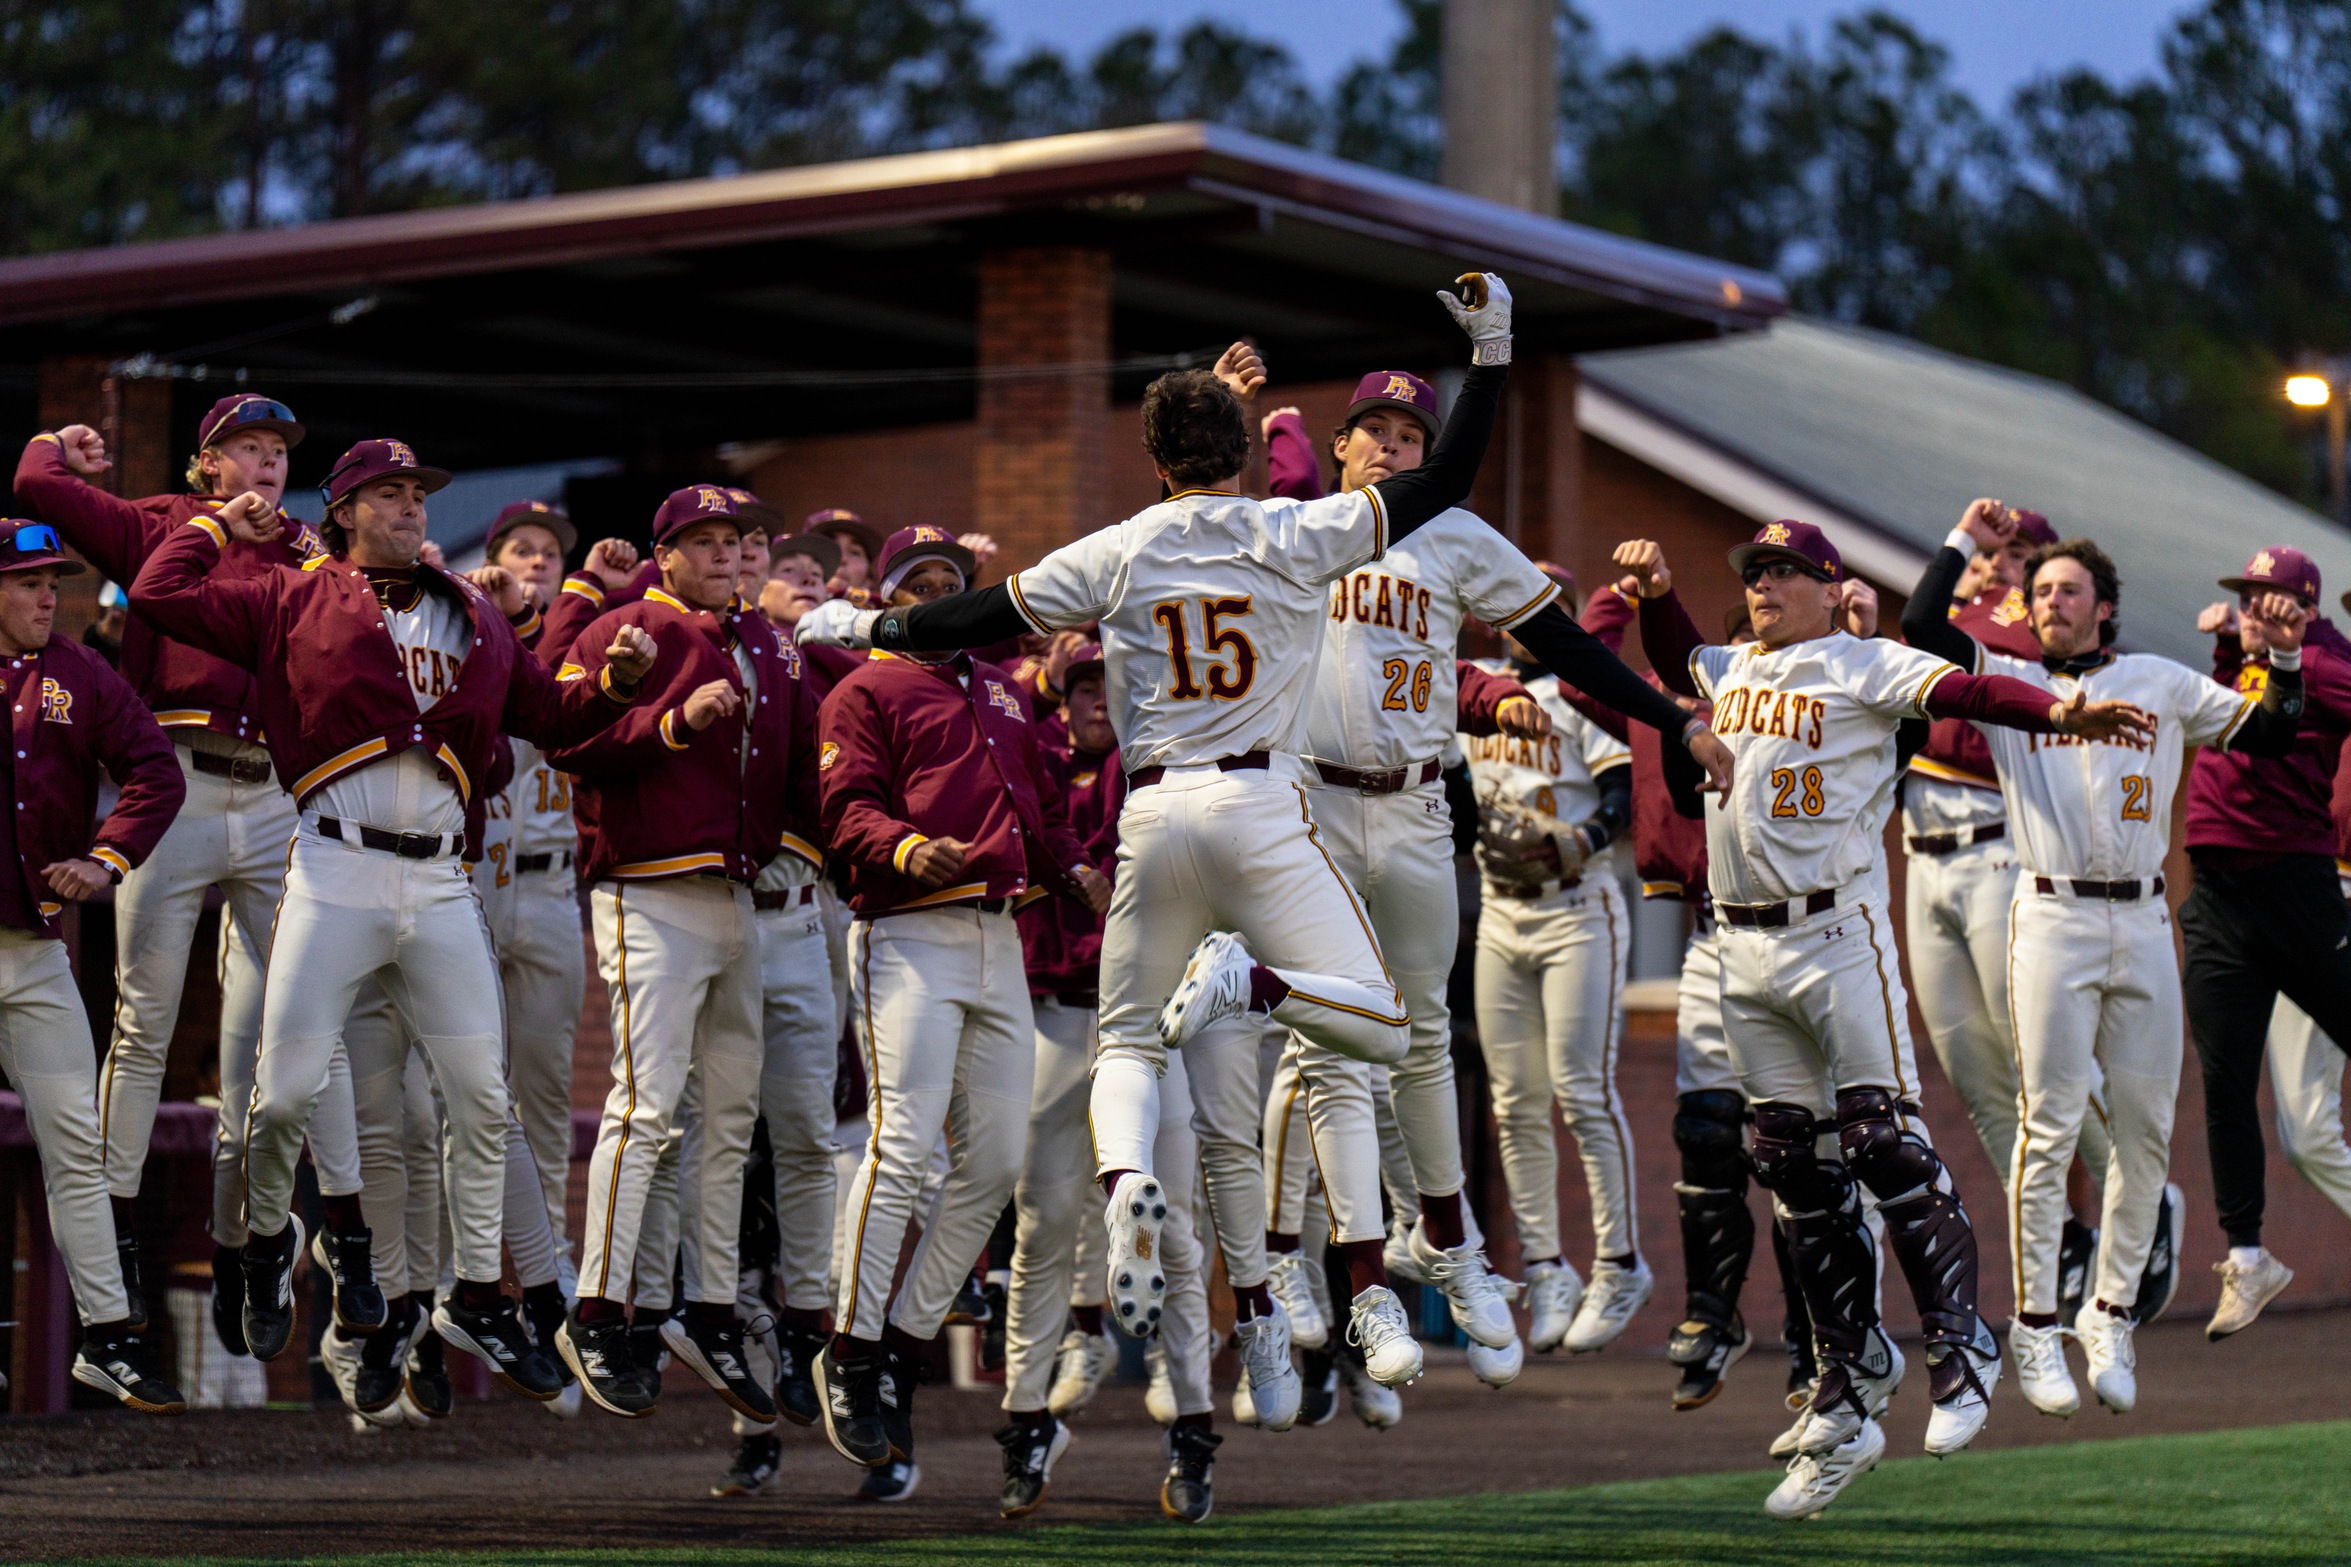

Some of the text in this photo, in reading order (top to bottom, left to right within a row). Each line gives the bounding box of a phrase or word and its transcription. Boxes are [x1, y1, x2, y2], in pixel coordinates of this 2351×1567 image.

[1382, 375, 1417, 403] PR
[698, 488, 730, 513] PR
[1328, 571, 1431, 643] DCATS
[399, 643, 462, 697] CAT
[1153, 596, 1257, 702] 15
[42, 677, 73, 725] PR
[984, 680, 1027, 723] PR
[1382, 659, 1432, 712] 26
[1712, 685, 1826, 751] ILDCATS
[1771, 765, 1826, 819] 28
[488, 832, 512, 890] 2
